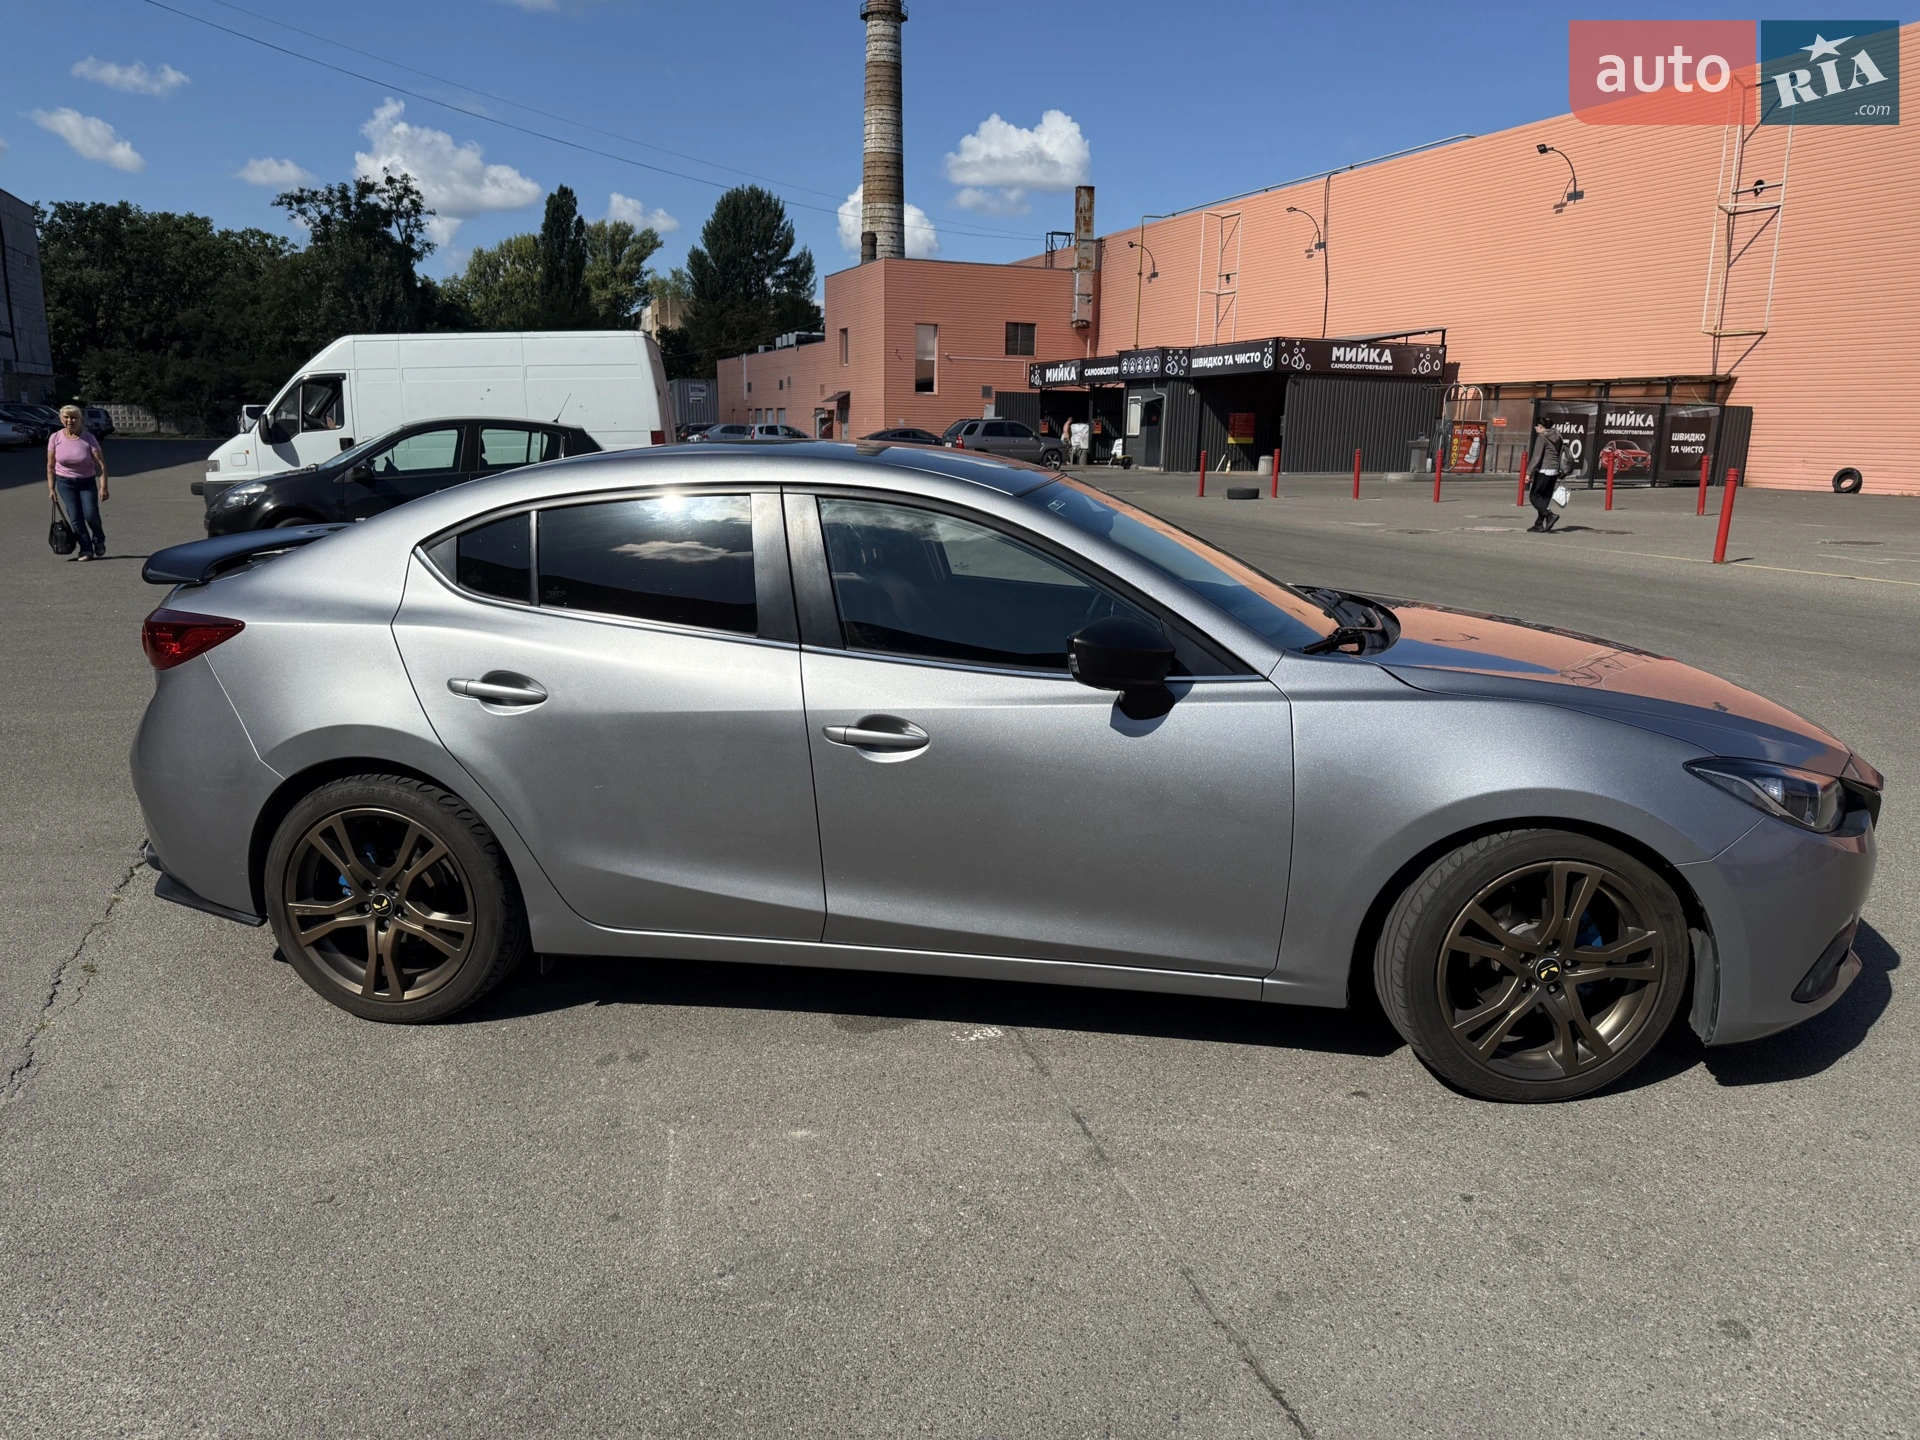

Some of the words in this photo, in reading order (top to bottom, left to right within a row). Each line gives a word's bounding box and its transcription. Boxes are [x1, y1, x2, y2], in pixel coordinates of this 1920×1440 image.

[1191, 355, 1223, 369] ШВИДКО
[1224, 354, 1234, 366] ТА
[1234, 352, 1261, 365] ЧИСТО
[1331, 343, 1393, 364] МИЙКА
[1045, 363, 1077, 382] МИЙКА
[1330, 362, 1394, 371] САМООБСЛУГОВУВАННЯ
[1605, 410, 1655, 428] МИЙКА
[1671, 432, 1706, 443] ШВИДКО
[1670, 445, 1680, 454] ТА
[1680, 445, 1704, 454] ЧИСТО
